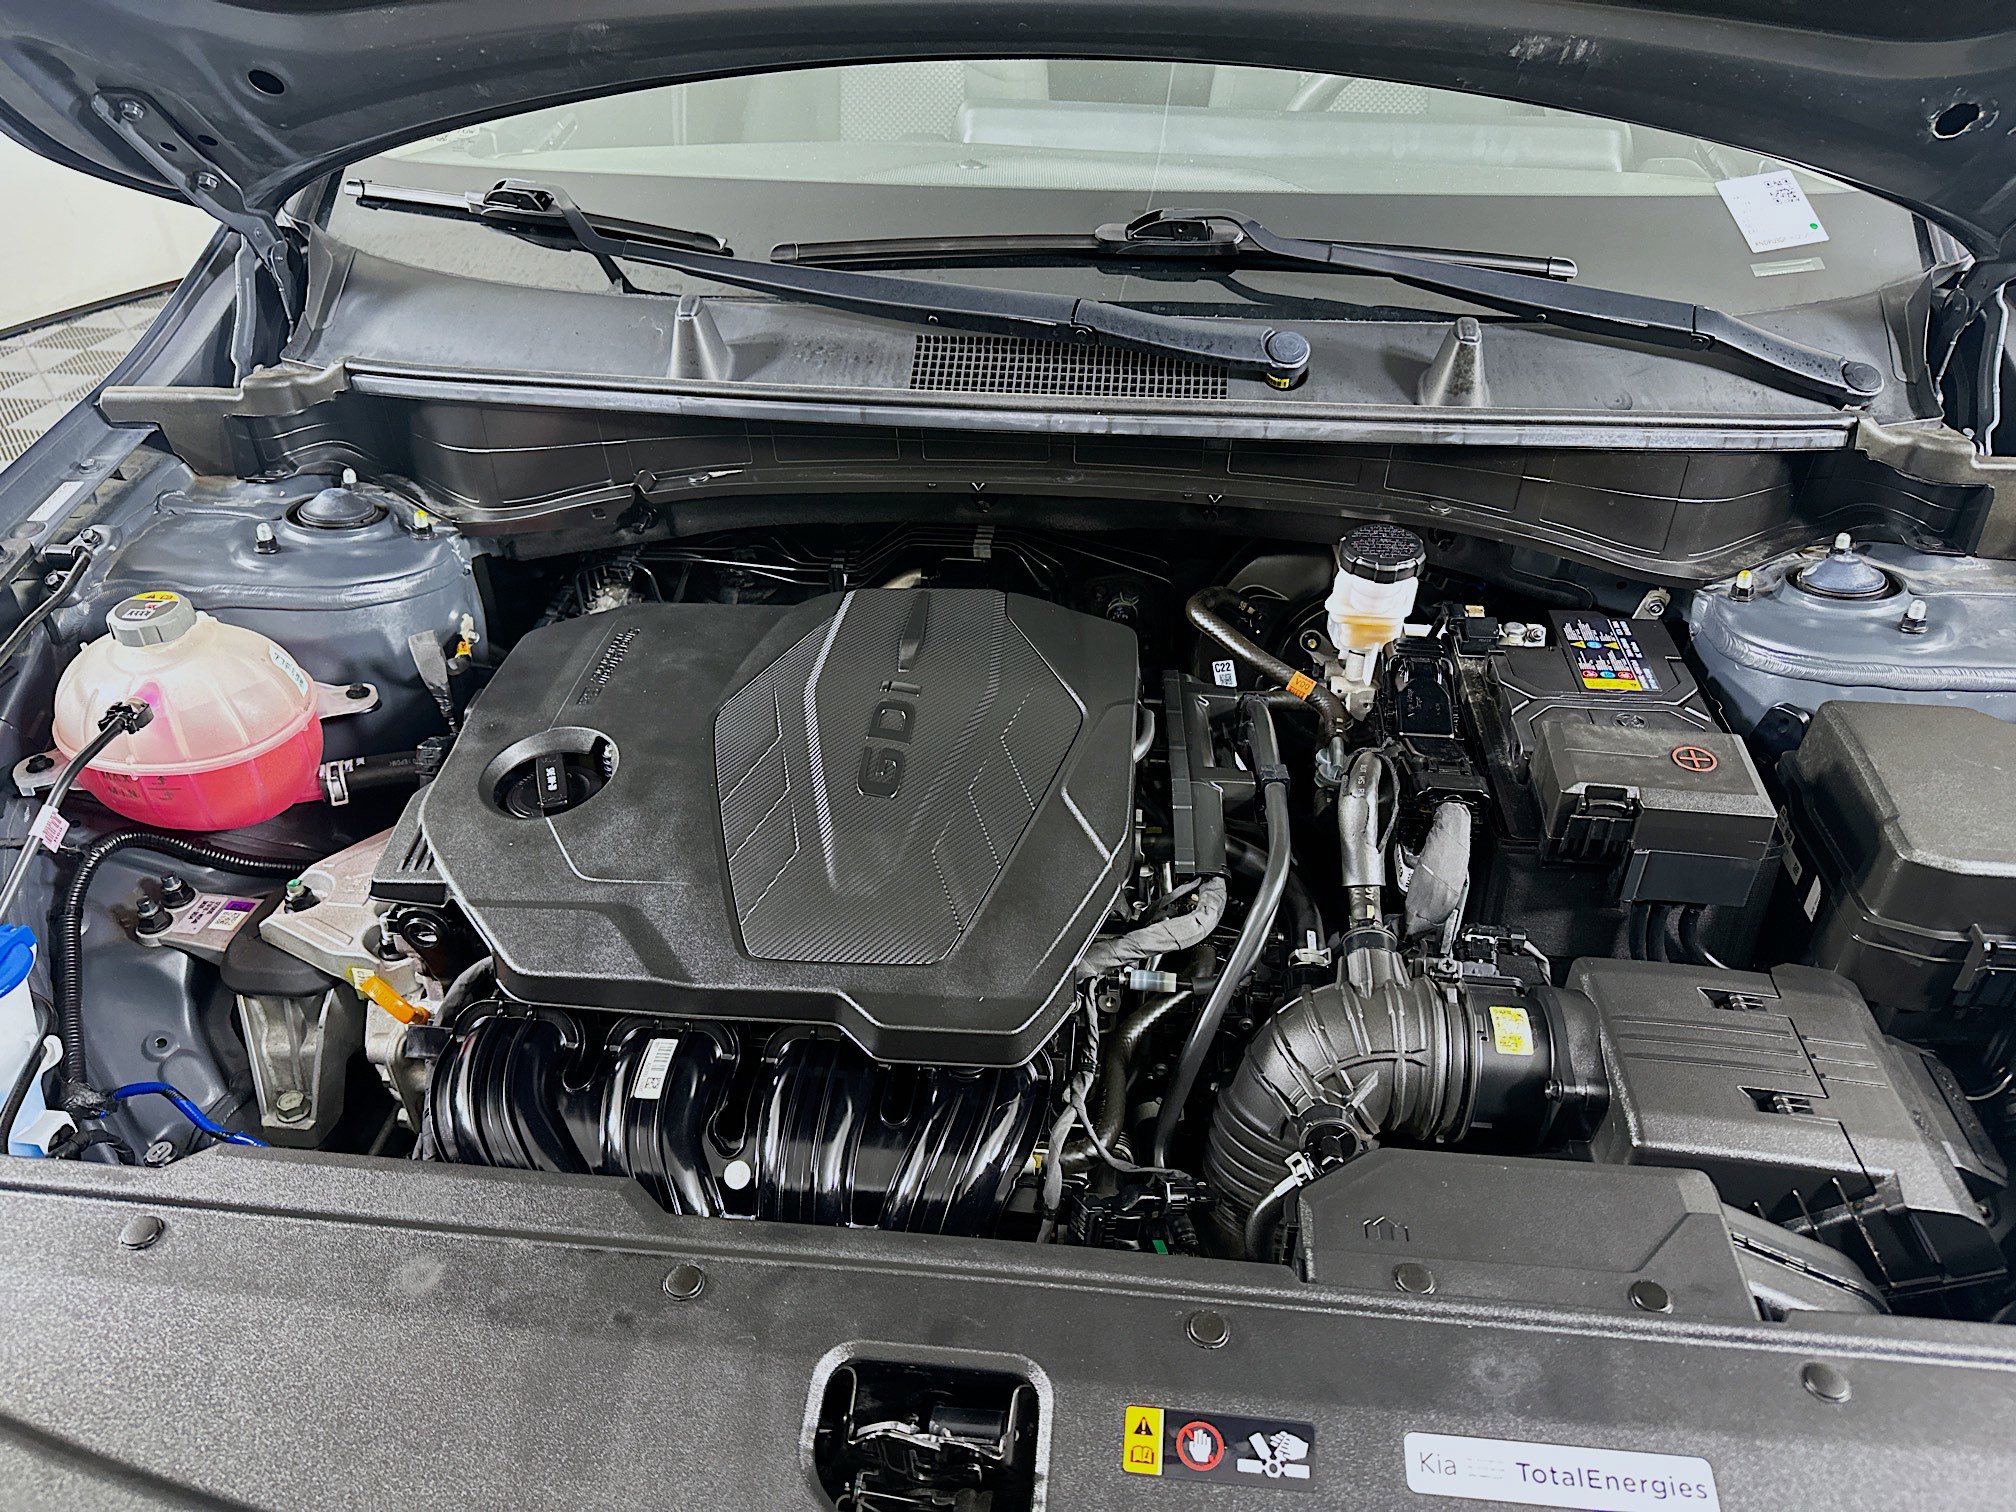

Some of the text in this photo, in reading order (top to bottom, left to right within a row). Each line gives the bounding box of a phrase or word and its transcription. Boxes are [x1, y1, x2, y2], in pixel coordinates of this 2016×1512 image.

[1214, 662, 1232, 673] C22
[1418, 1451, 1709, 1500] Kia TotalEnergies
